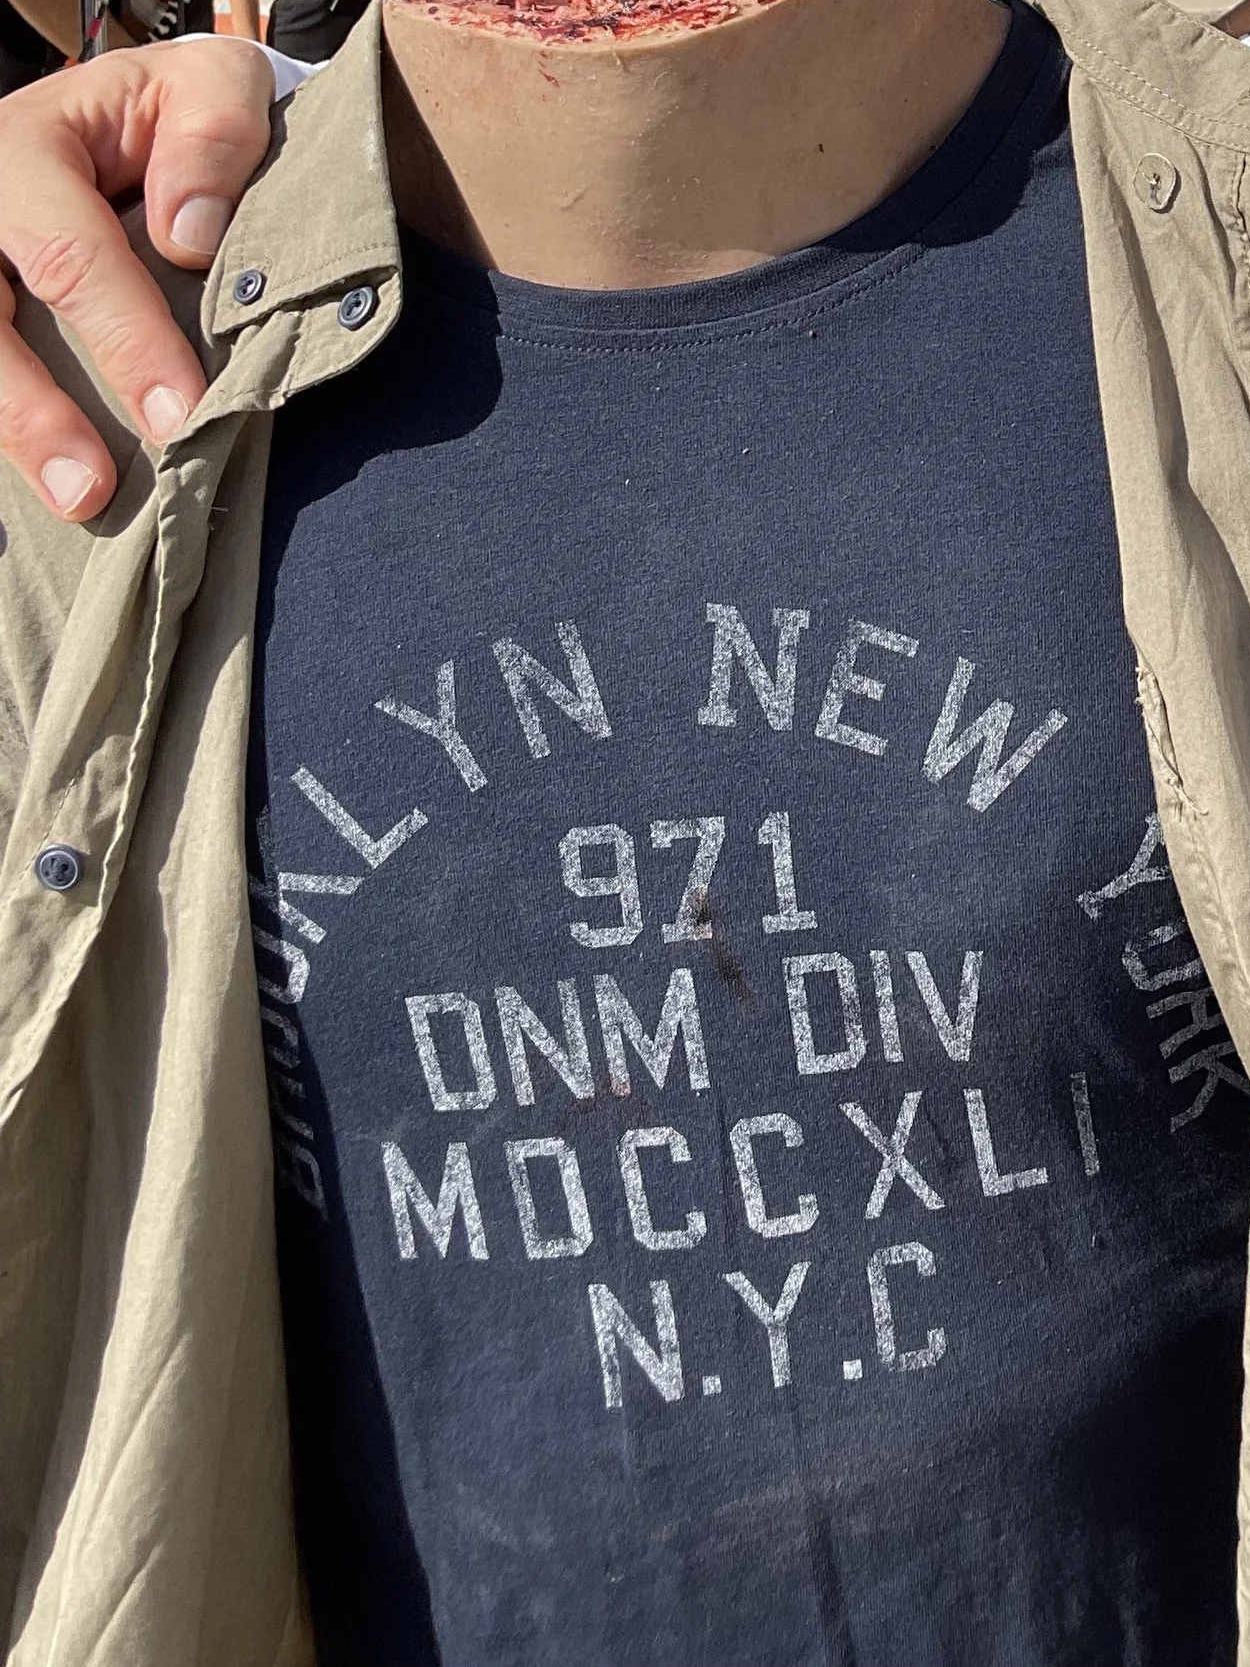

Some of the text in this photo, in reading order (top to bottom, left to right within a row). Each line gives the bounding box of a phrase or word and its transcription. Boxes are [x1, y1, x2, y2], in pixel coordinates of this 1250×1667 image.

[696, 601, 1068, 812] NEW
[558, 810, 818, 948] 971
[404, 949, 984, 1111] DNM DIV
[588, 1240, 946, 1408] N.Y.C
